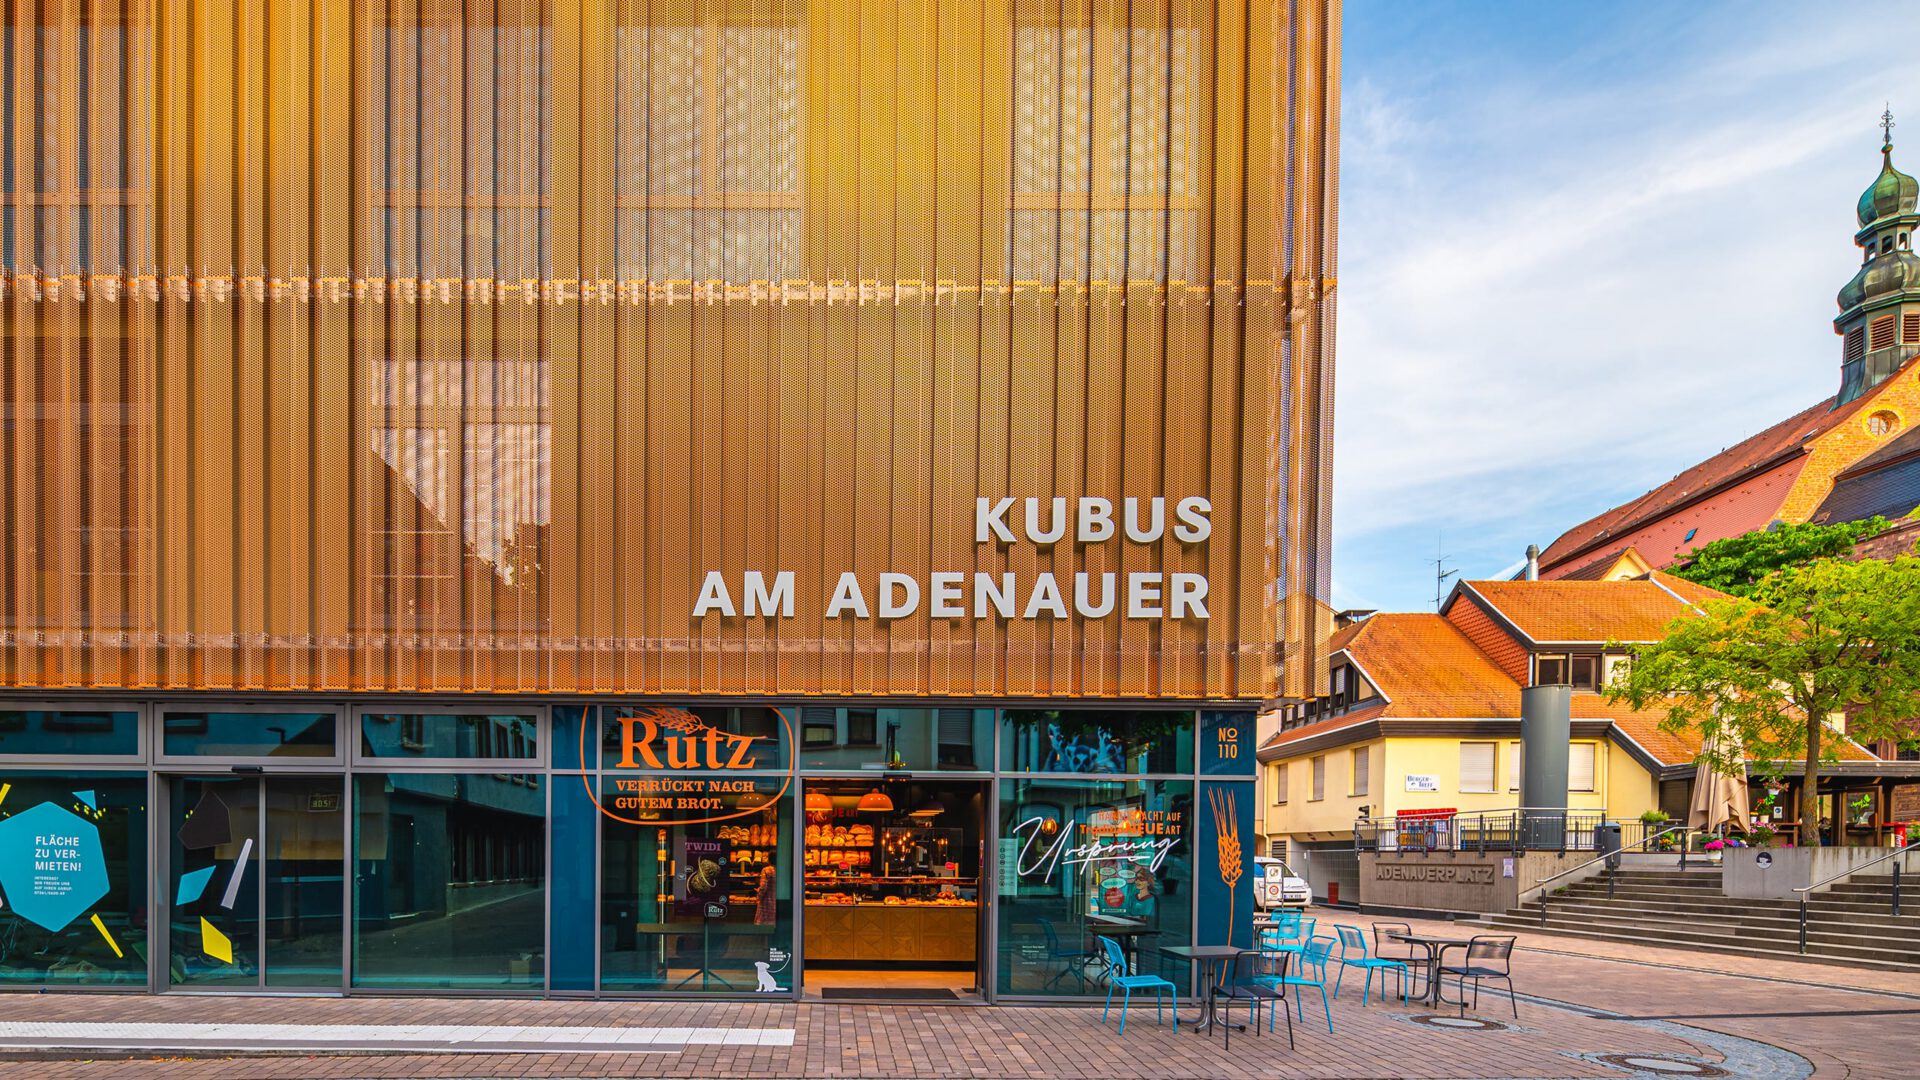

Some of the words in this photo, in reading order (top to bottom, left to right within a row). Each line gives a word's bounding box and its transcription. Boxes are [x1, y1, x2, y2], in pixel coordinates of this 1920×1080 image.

[975, 496, 1213, 543] KUBUS
[692, 571, 796, 617] AM
[826, 572, 1210, 618] ADENAUER
[615, 717, 757, 769] Rutz
[1218, 744, 1238, 759] 110
[615, 778, 705, 792] VERRÜCKT
[708, 781, 755, 793] NACH
[615, 797, 673, 809] GUTEM
[677, 797, 724, 810] BROT.
[1166, 812, 1182, 822] AUF
[1165, 825, 1182, 836] ART
[35, 834, 80, 846] FLÄCHE
[35, 848, 50, 858] ZU
[54, 849, 81, 859] VER-
[1012, 816, 1182, 884] Ursprung
[35, 861, 82, 872] MIETEN!
[1376, 865, 1494, 884] ADENAUERPLATZ
